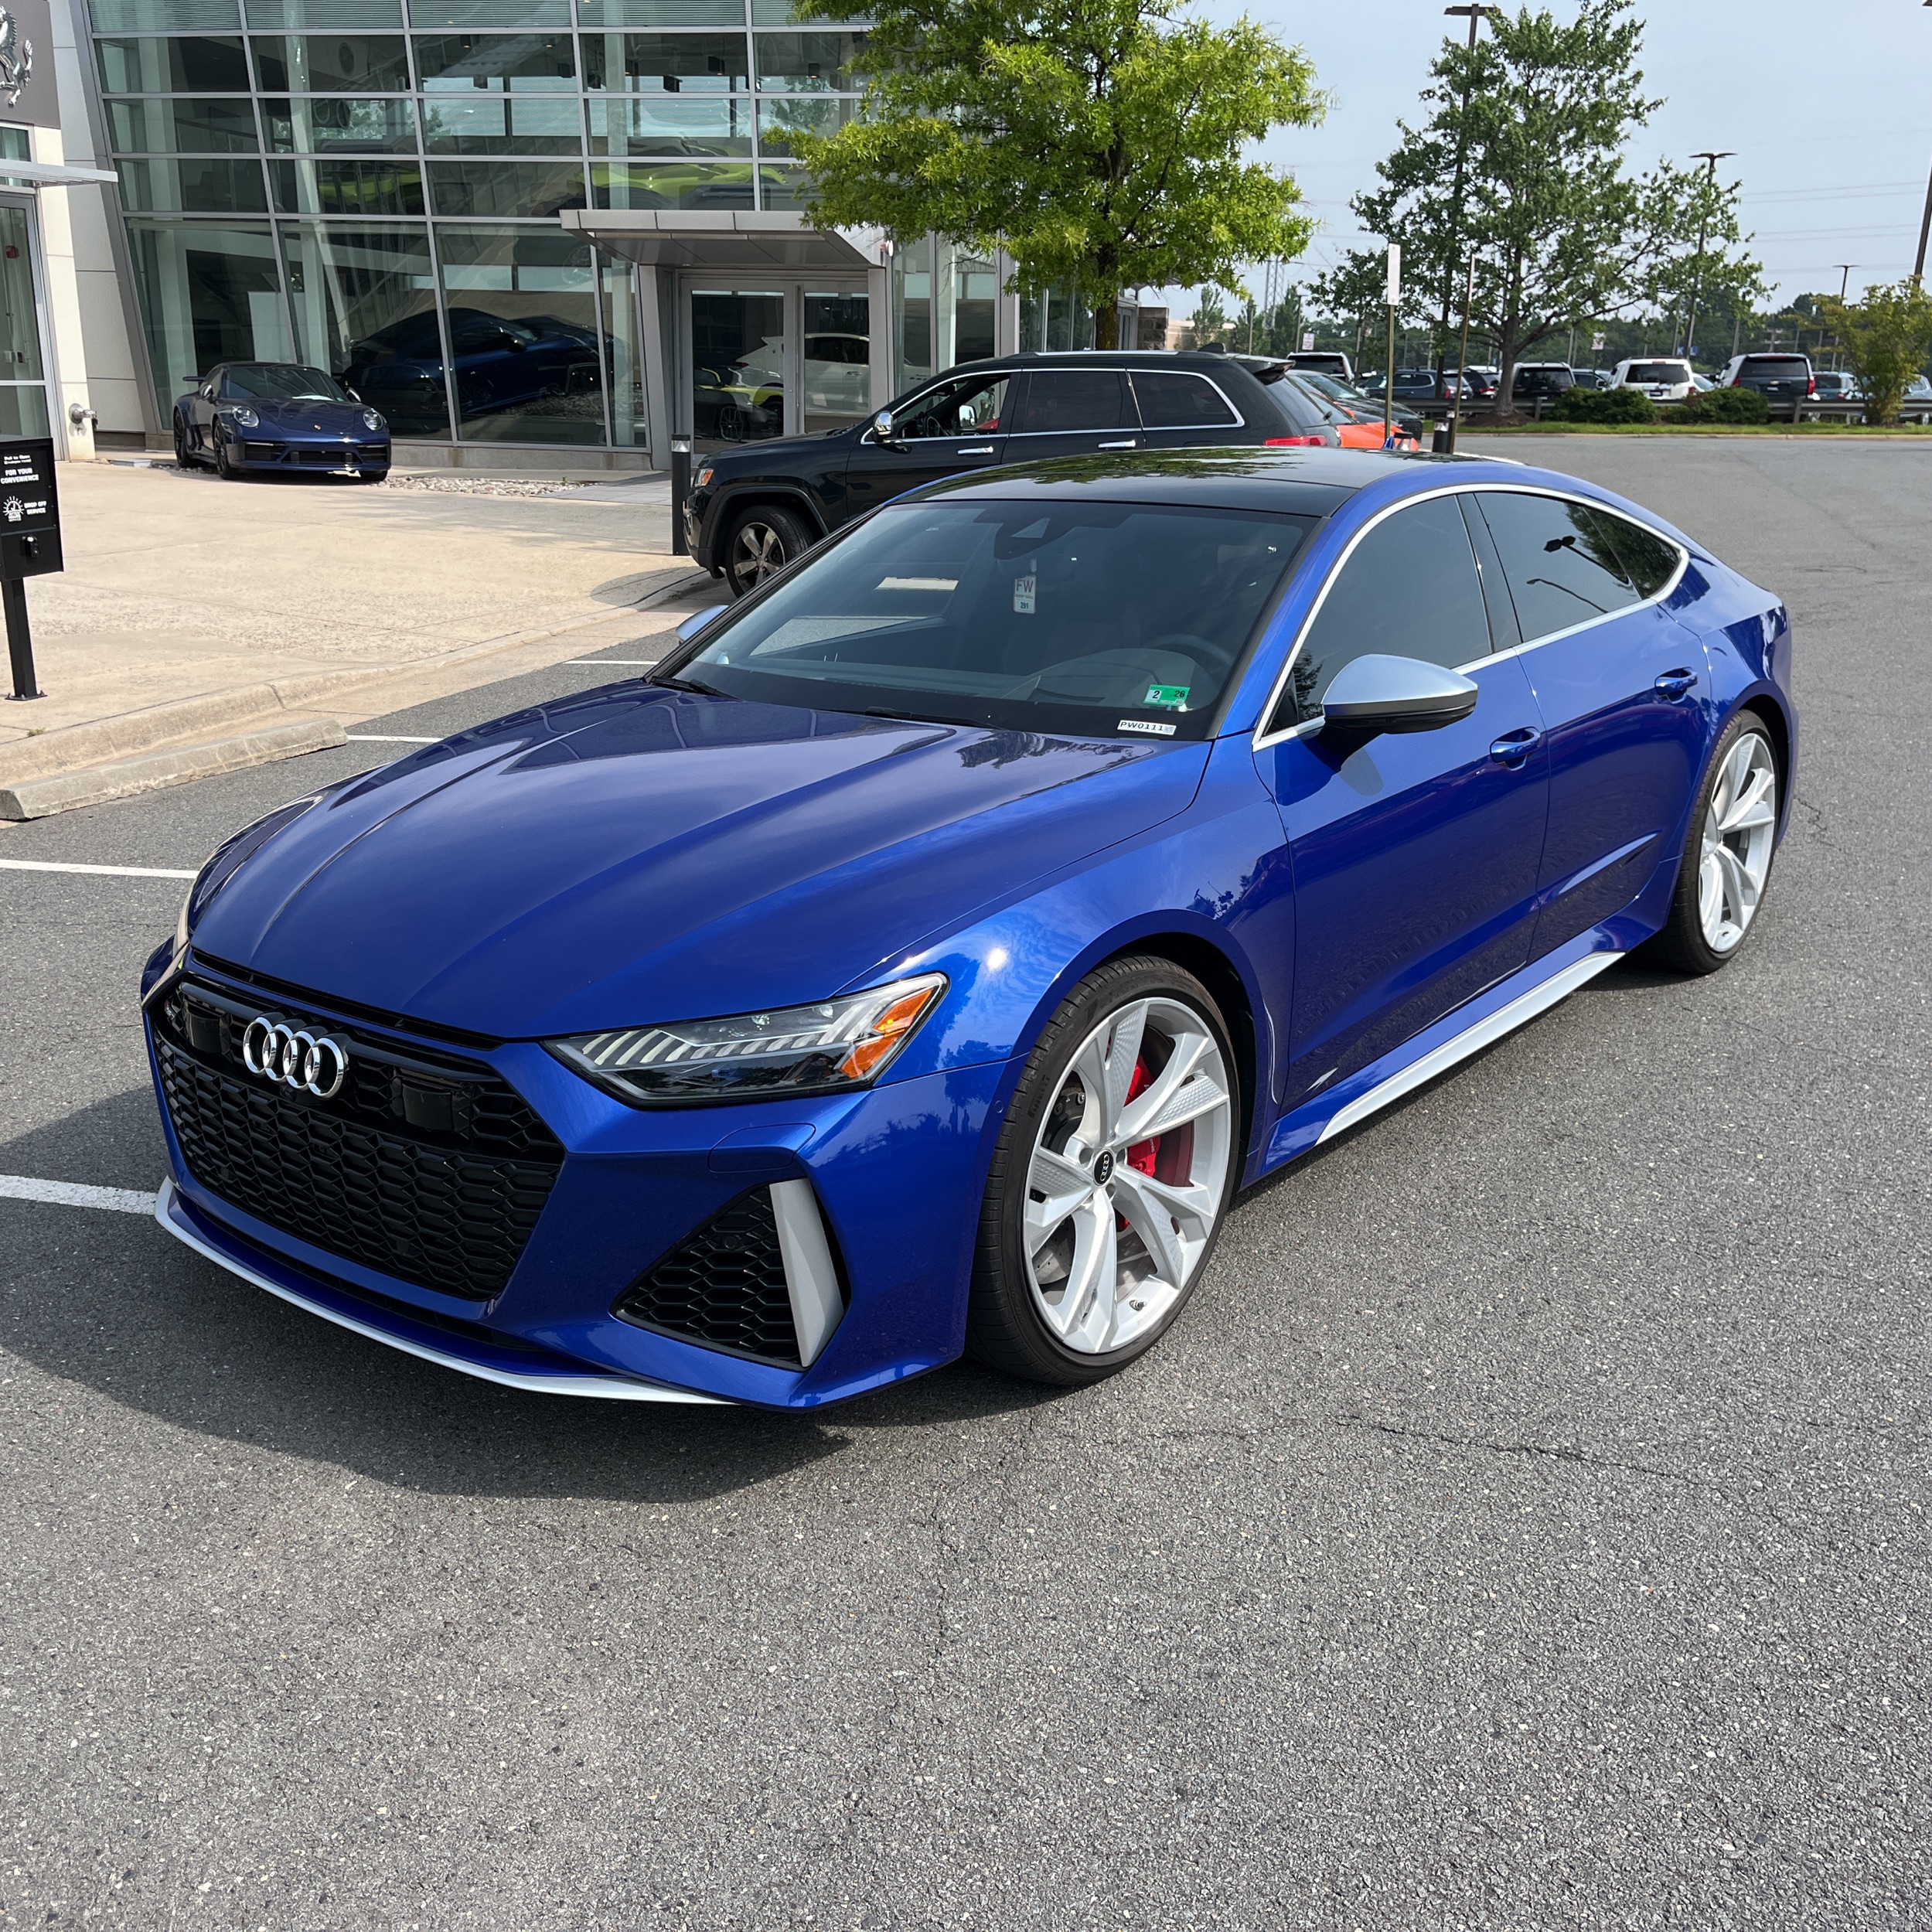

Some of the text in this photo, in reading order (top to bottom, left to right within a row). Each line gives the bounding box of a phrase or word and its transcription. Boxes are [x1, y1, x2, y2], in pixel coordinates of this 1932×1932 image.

[0, 474, 39, 484] CONVENIENCE
[1017, 579, 1034, 593] FW
[1153, 690, 1160, 699] 2
